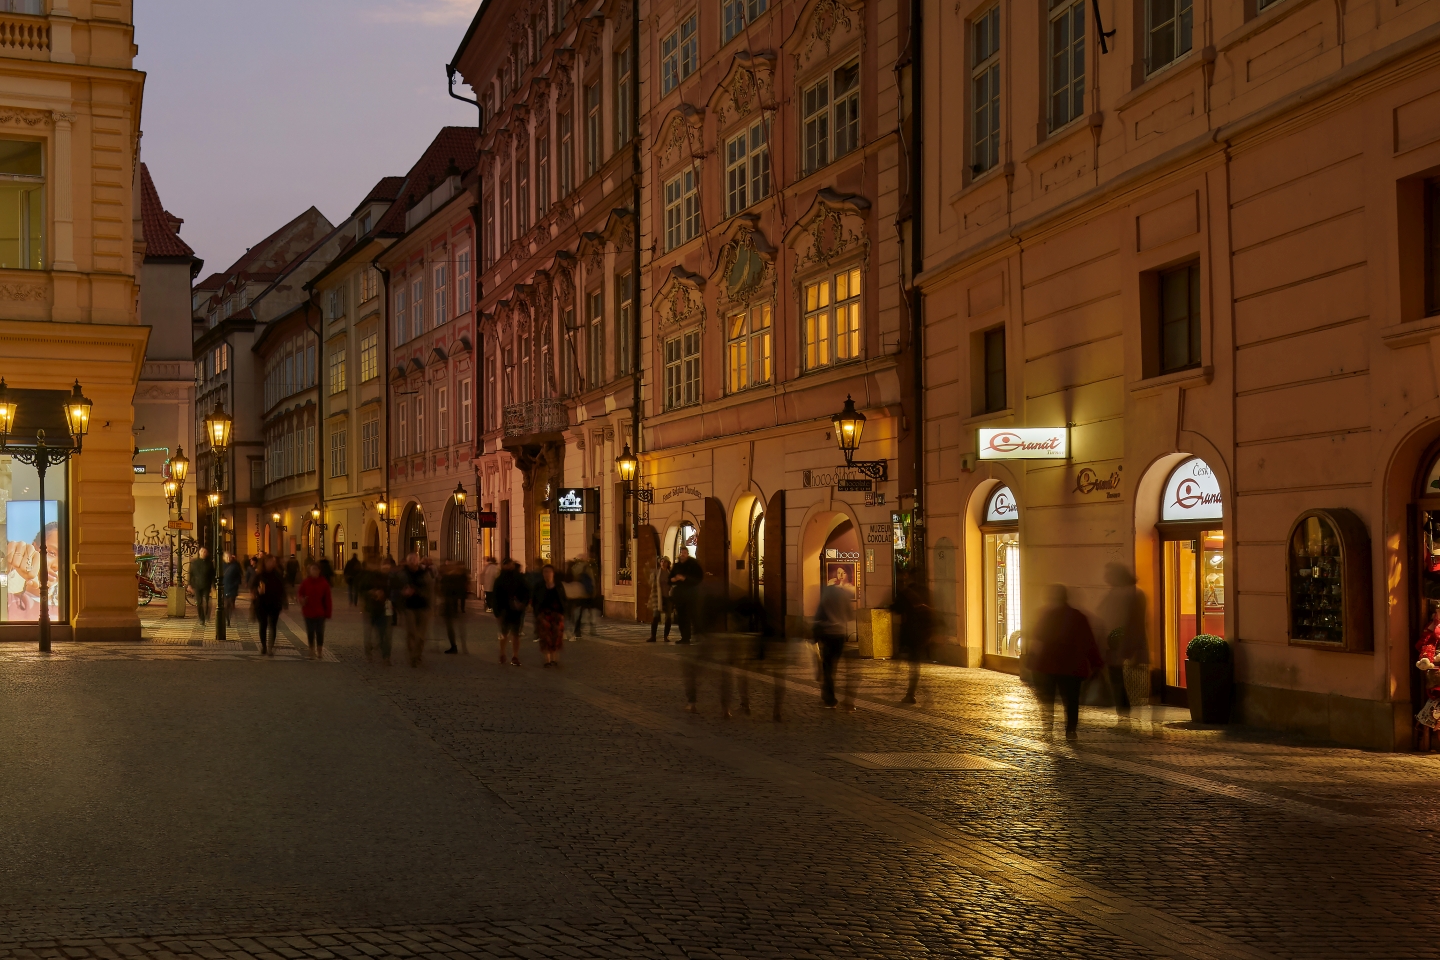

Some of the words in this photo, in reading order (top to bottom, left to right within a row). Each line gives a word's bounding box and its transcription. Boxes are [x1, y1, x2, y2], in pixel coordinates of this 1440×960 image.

[980, 432, 1062, 453] Granát
[1169, 478, 1223, 510] Grana
[867, 532, 892, 543] ČOKOLÁD
